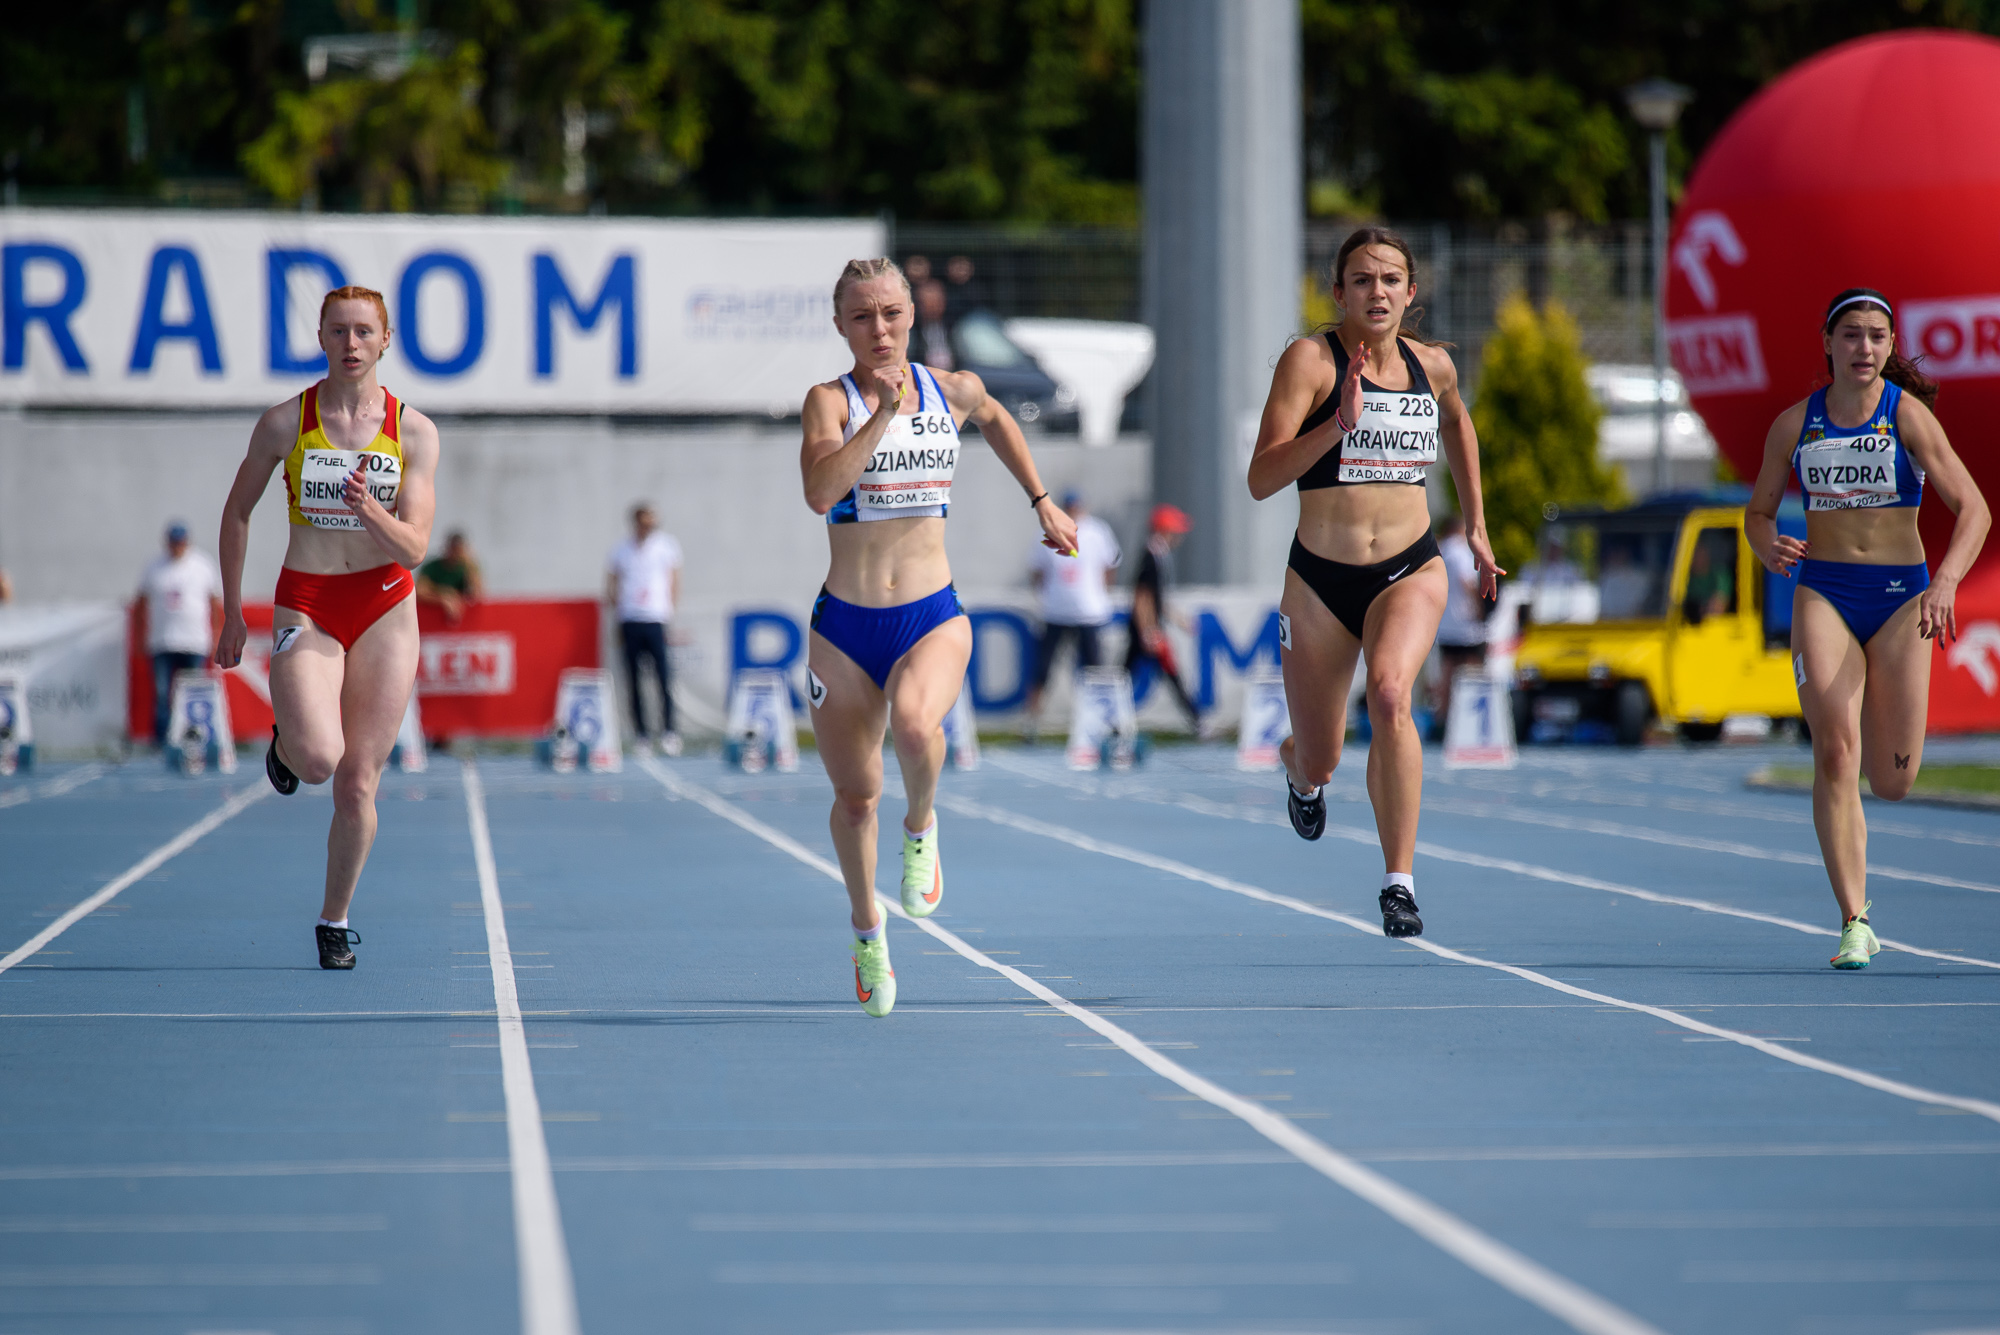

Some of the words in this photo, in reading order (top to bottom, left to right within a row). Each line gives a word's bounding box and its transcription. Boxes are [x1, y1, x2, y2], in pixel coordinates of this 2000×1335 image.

[1, 242, 640, 378] RADOM
[1399, 397, 1434, 417] 228
[911, 416, 951, 435] 566
[1347, 430, 1435, 451] KRAWCZYK
[1850, 437, 1891, 453] 409
[317, 457, 347, 467] FUEL
[863, 449, 954, 473] DZIAMSKA
[1348, 468, 1394, 480] RADOM
[1808, 466, 1888, 485] BYZDRA
[868, 493, 917, 504] RADOM
[1816, 499, 1852, 509] RADOM
[1855, 494, 1882, 509] 2022
[307, 515, 350, 527] RADOM
[277, 628, 296, 652] 7
